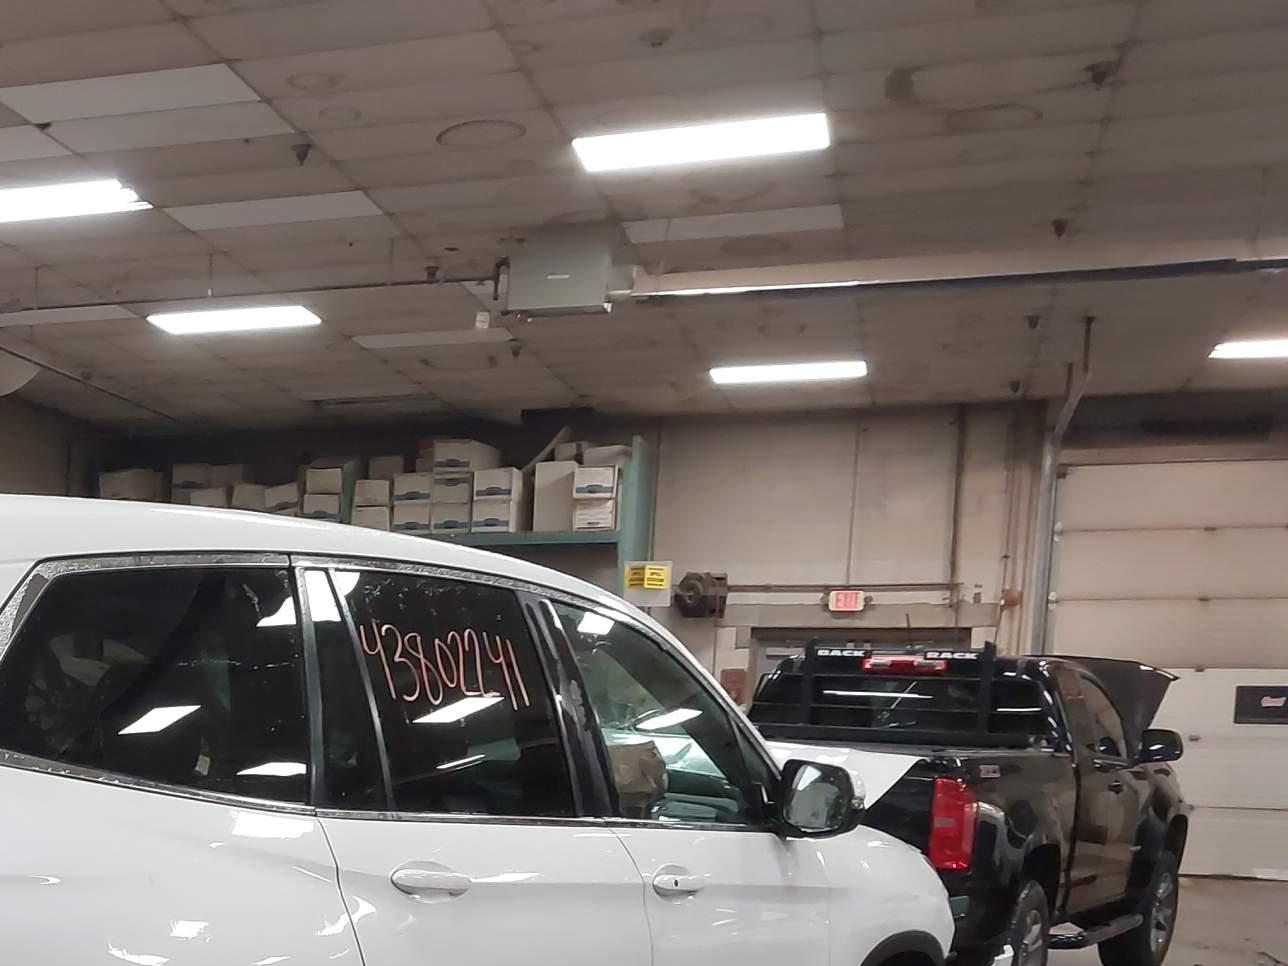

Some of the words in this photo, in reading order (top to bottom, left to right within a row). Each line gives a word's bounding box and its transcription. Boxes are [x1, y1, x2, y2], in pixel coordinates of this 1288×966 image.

[359, 619, 530, 711] 43802241
[817, 649, 865, 657] BACK
[926, 652, 978, 660] RACK
